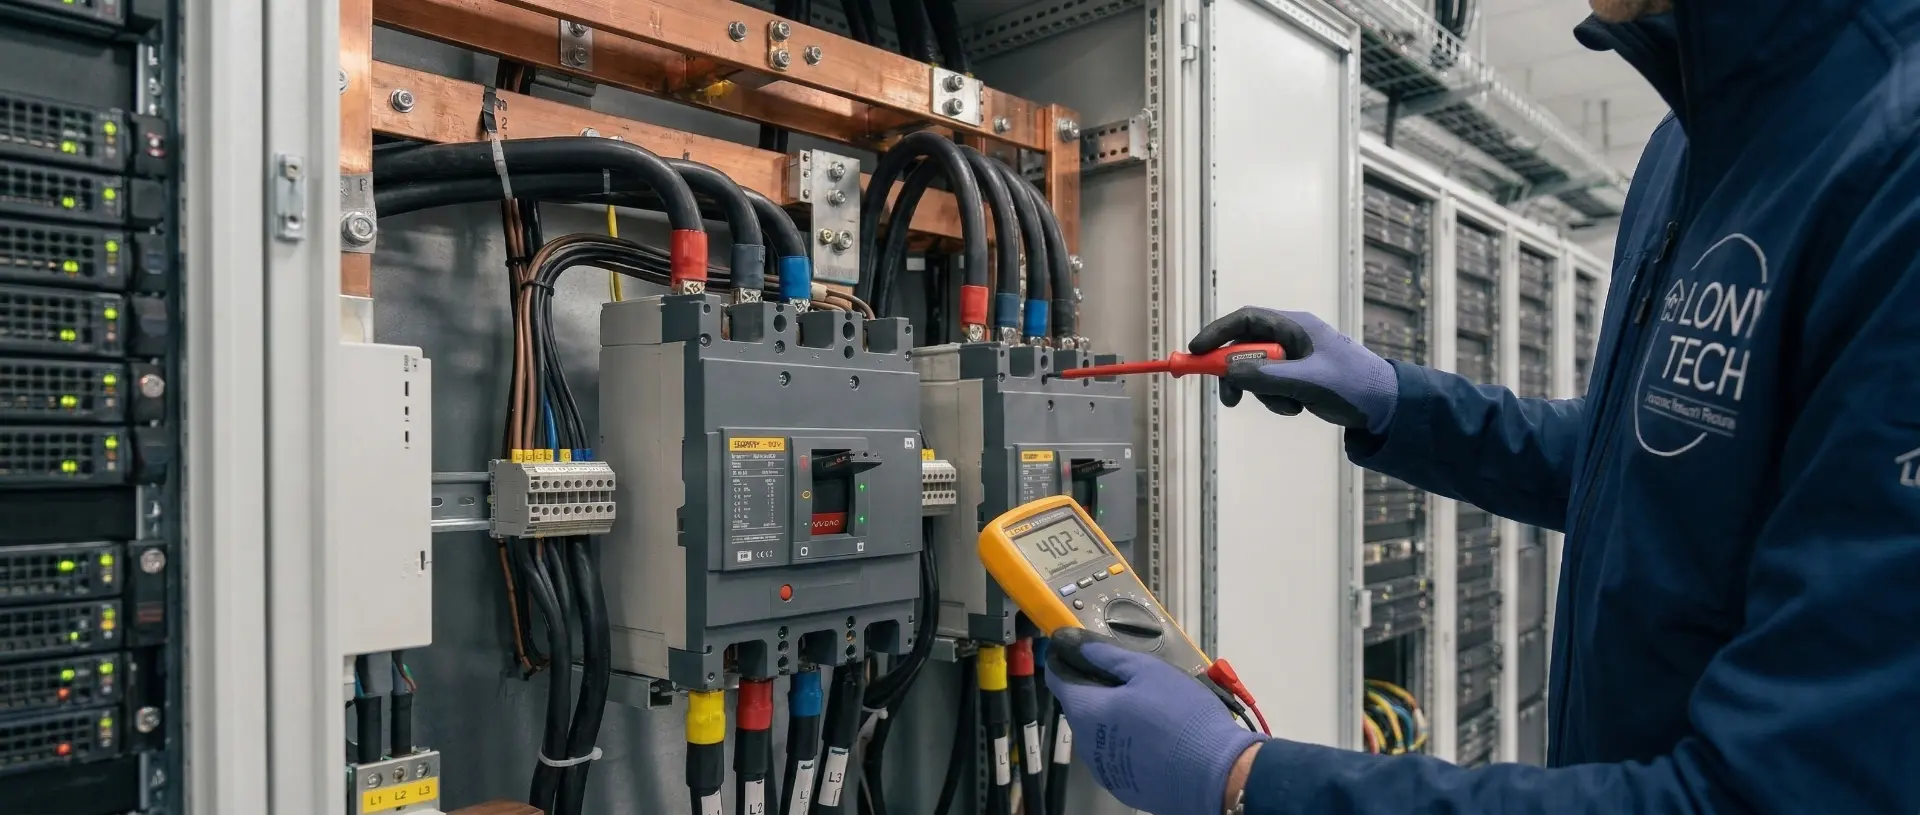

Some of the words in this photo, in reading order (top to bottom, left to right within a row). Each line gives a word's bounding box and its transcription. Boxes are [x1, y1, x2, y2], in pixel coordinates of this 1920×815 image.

[1661, 335, 1751, 402] TECH
[828, 771, 842, 783] L3
[370, 795, 382, 806] L1
[394, 790, 407, 801] L2
[418, 785, 430, 796] L3
[749, 802, 763, 815] L2
